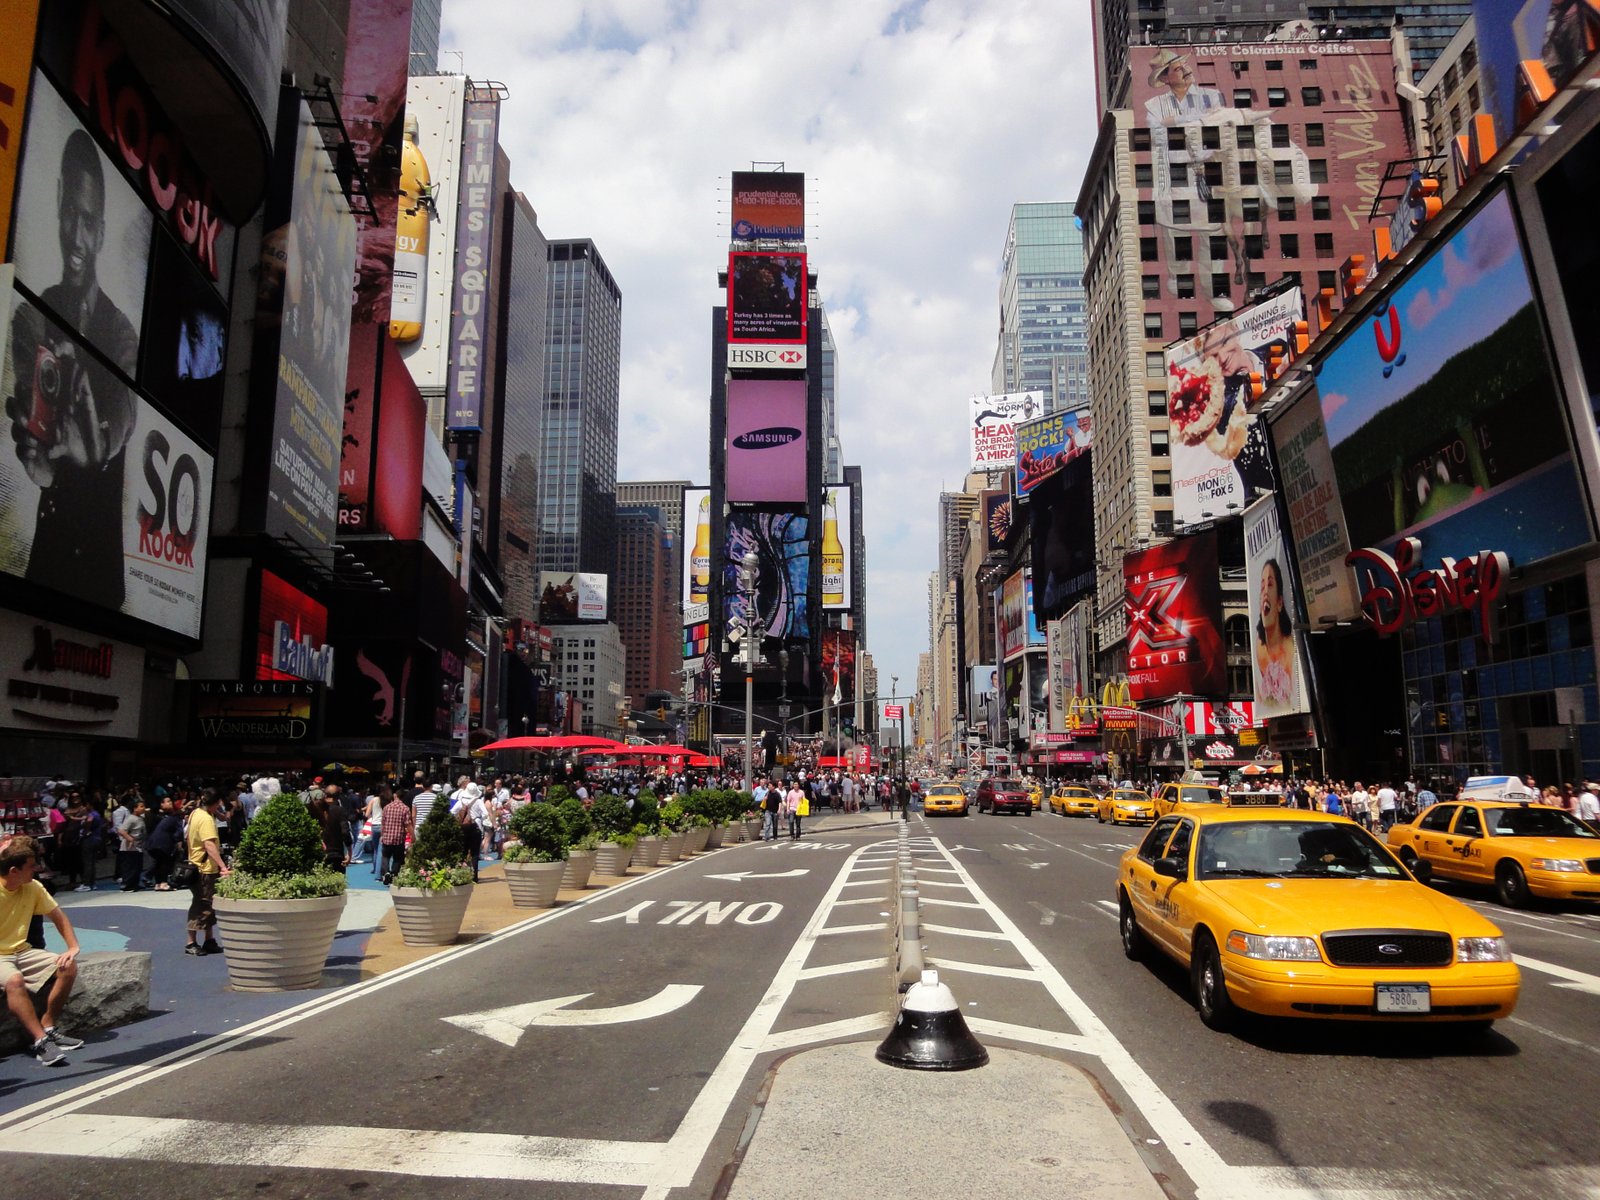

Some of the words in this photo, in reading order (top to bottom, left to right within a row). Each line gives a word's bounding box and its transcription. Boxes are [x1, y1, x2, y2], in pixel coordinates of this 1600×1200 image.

[1196, 46, 1227, 56] 100%
[1232, 45, 1305, 55] Colombian
[1309, 44, 1355, 54] Coffee
[466, 119, 492, 232] TIMES
[735, 197, 802, 206] 1-800-THE-ROCK
[739, 190, 797, 199] prudential.com
[754, 225, 802, 234] Prudential
[456, 246, 486, 393] SQUARE
[1243, 305, 1279, 329] WINNING
[1252, 322, 1263, 333] NO
[732, 350, 777, 363] HSBC
[456, 410, 473, 418] NYC
[1020, 416, 1064, 439] NUNS
[742, 433, 793, 443] SAMSUNG
[975, 438, 988, 446] ON
[1020, 430, 1064, 454] ROCK!
[274, 450, 290, 479] LIVE
[280, 438, 315, 478] SATURDAY
[976, 452, 985, 462] A
[1019, 450, 1061, 485] Sister
[1174, 464, 1232, 490] MasterChef
[1197, 477, 1219, 494] MON
[1220, 472, 1234, 489] 6/6
[137, 430, 199, 549] SO
[1211, 488, 1227, 500] FOX
[1228, 485, 1234, 495] 5
[273, 620, 313, 681] Bank
[1140, 672, 1159, 683] FALL
[200, 683, 314, 694] MARQUIS
[200, 718, 307, 739] WONDERLAND
[755, 842, 851, 850] ONLY
[588, 901, 784, 925] ONLY
